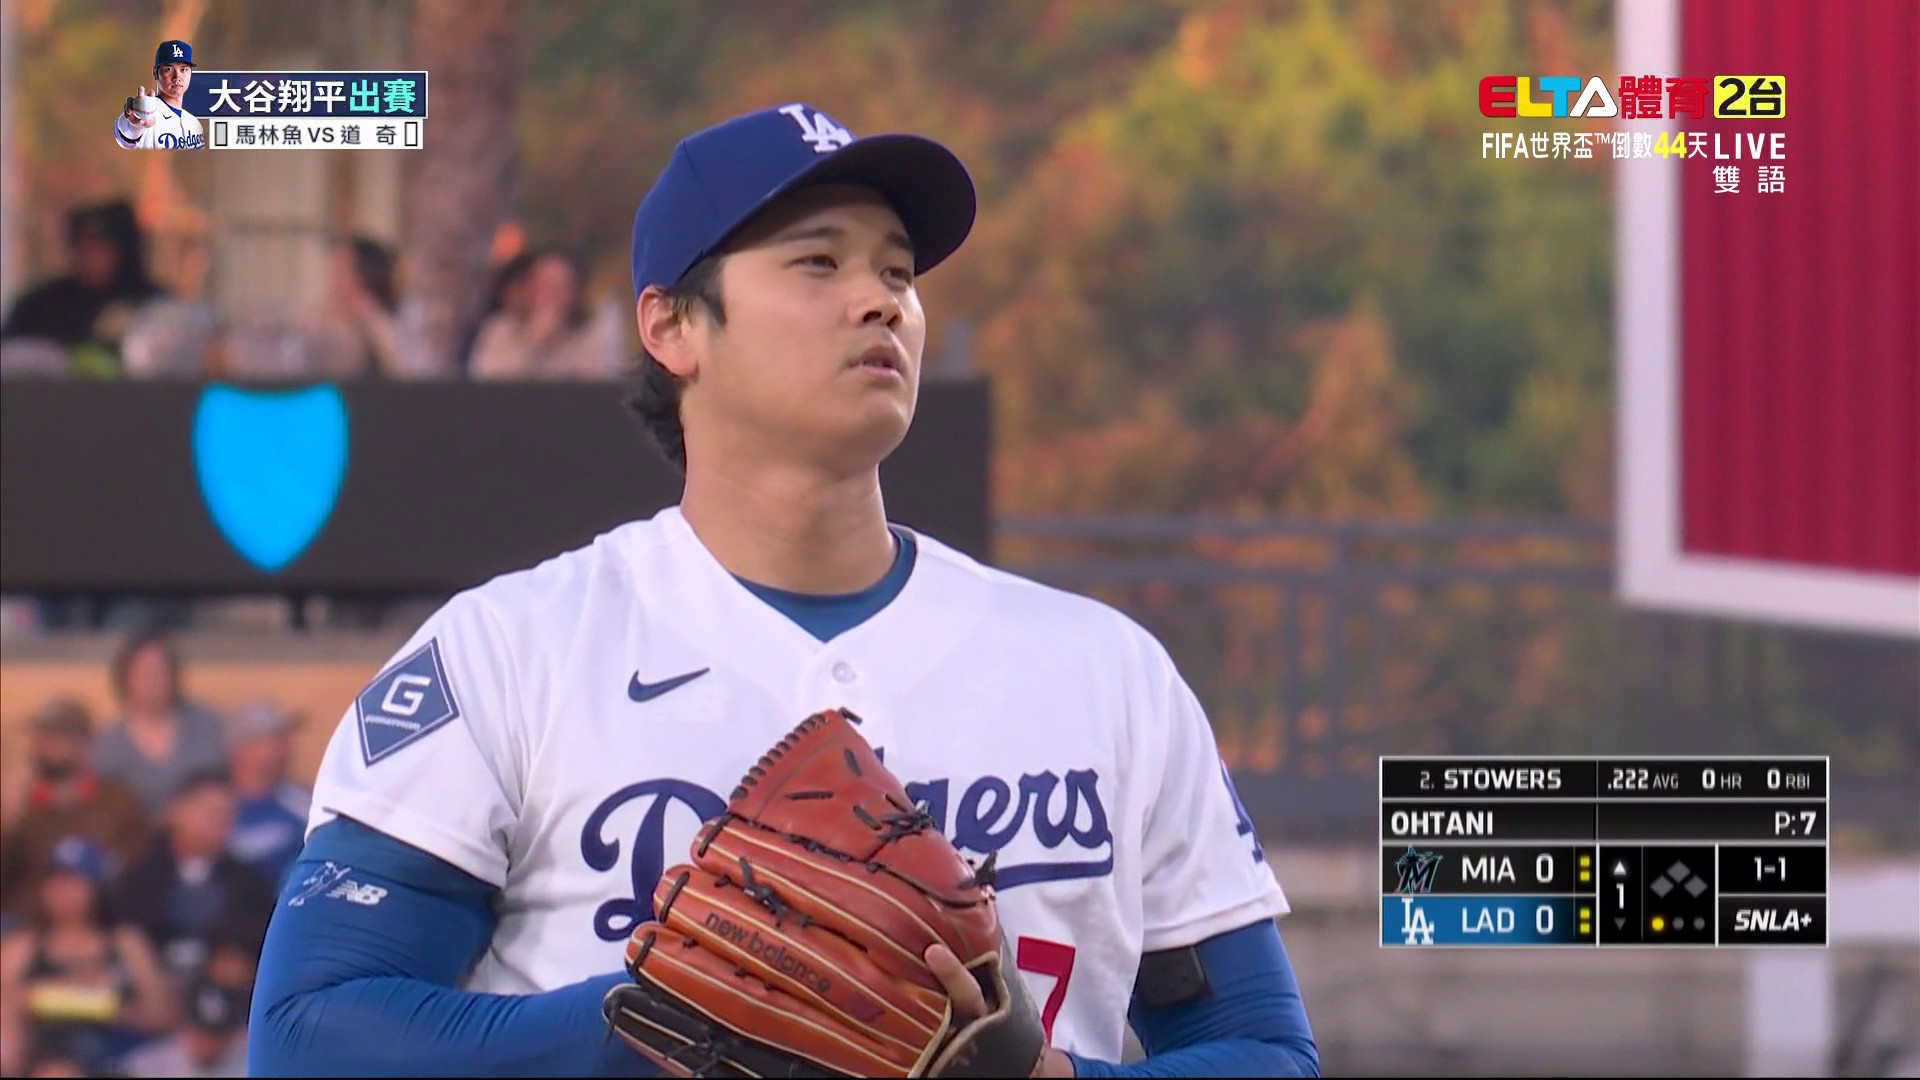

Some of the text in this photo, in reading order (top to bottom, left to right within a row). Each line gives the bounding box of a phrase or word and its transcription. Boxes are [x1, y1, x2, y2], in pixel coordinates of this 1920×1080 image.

[778, 103, 852, 153] LA
[381, 673, 431, 716] G
[705, 912, 832, 994] new balance
